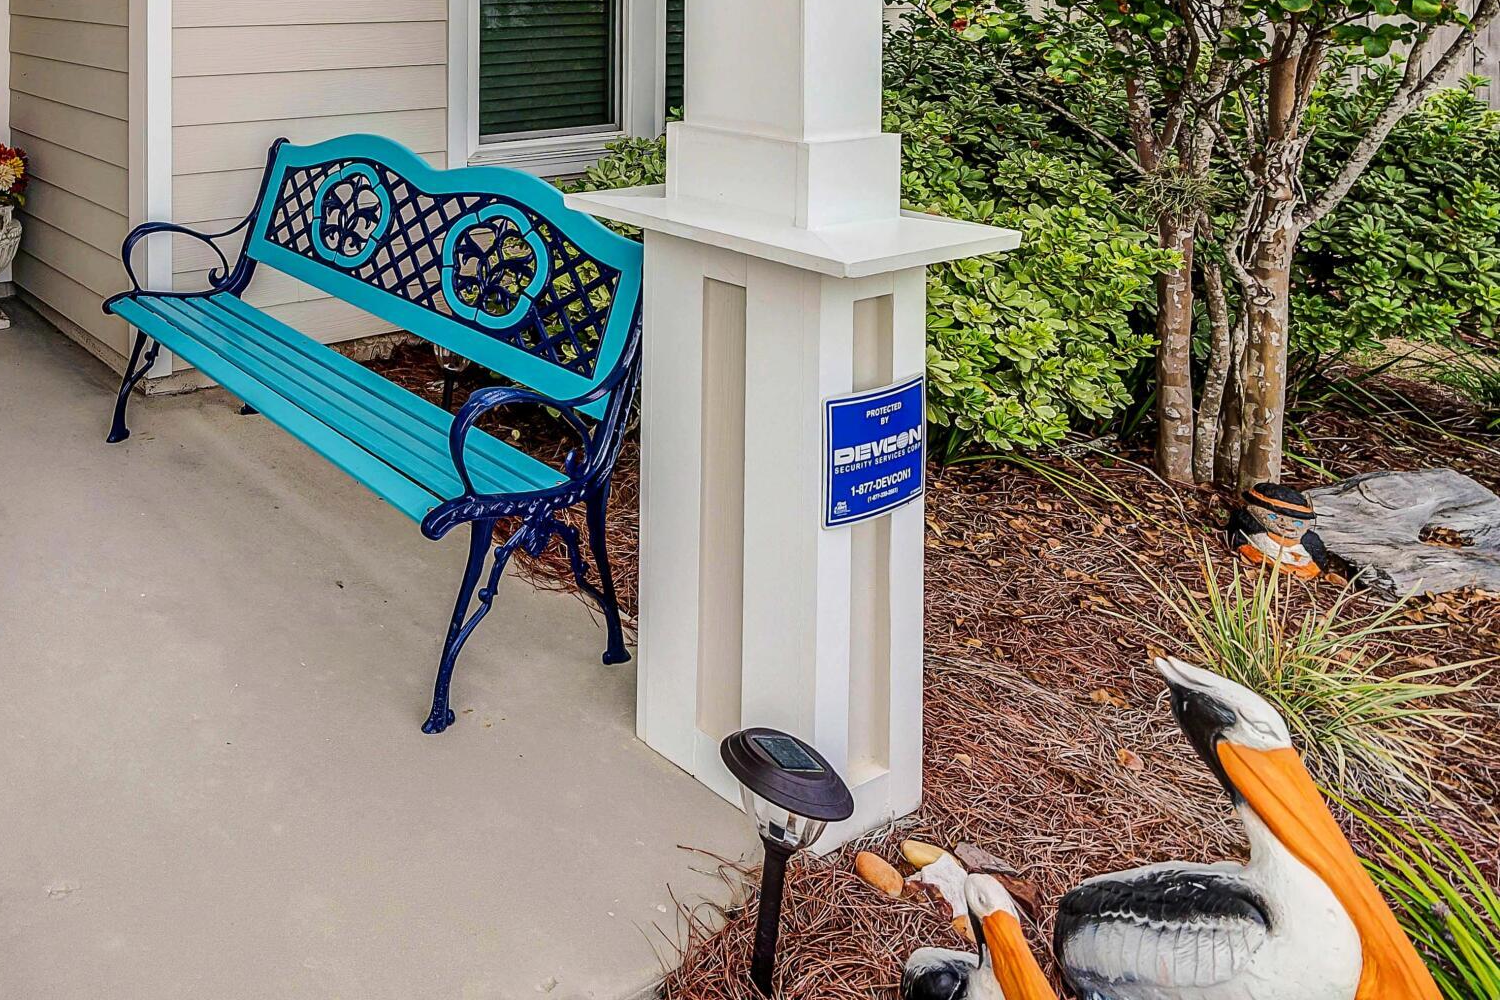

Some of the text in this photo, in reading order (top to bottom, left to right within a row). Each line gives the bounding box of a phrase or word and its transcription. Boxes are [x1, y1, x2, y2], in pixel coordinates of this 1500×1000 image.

[866, 401, 902, 418] PROTECTED
[880, 415, 889, 425] BY
[834, 424, 922, 466] DEVCON
[834, 460, 872, 475] SECURITY
[874, 449, 906, 465] SERVICES
[850, 467, 911, 496] 1-877-DEVCON1
